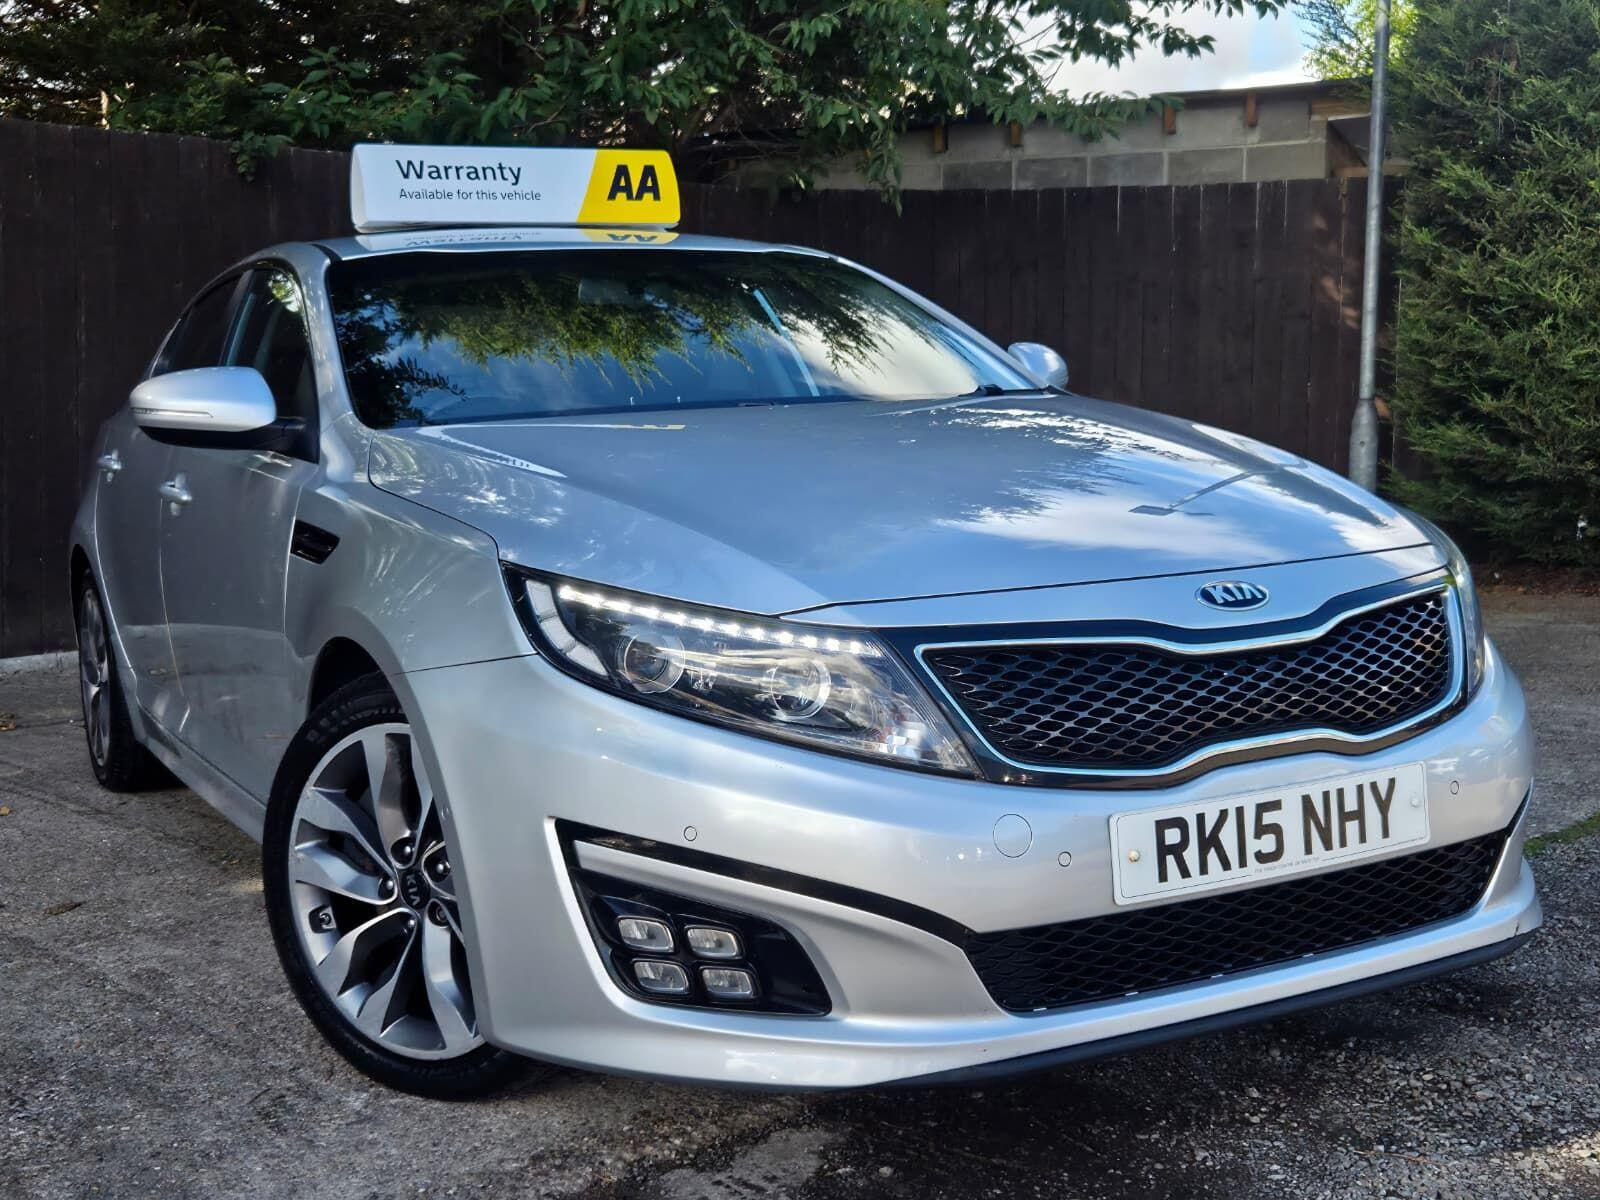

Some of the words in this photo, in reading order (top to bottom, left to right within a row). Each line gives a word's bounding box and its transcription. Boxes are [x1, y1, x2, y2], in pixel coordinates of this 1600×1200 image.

[396, 159, 522, 185] Warranty
[607, 165, 661, 201] AA
[399, 188, 453, 200] Available
[456, 189, 473, 200] for
[476, 189, 498, 201] this
[500, 190, 541, 201] vehicle
[1205, 583, 1263, 604] KIA
[1154, 799, 1284, 883] RK15
[1301, 777, 1396, 855] NHY
[406, 873, 421, 906] KIA
